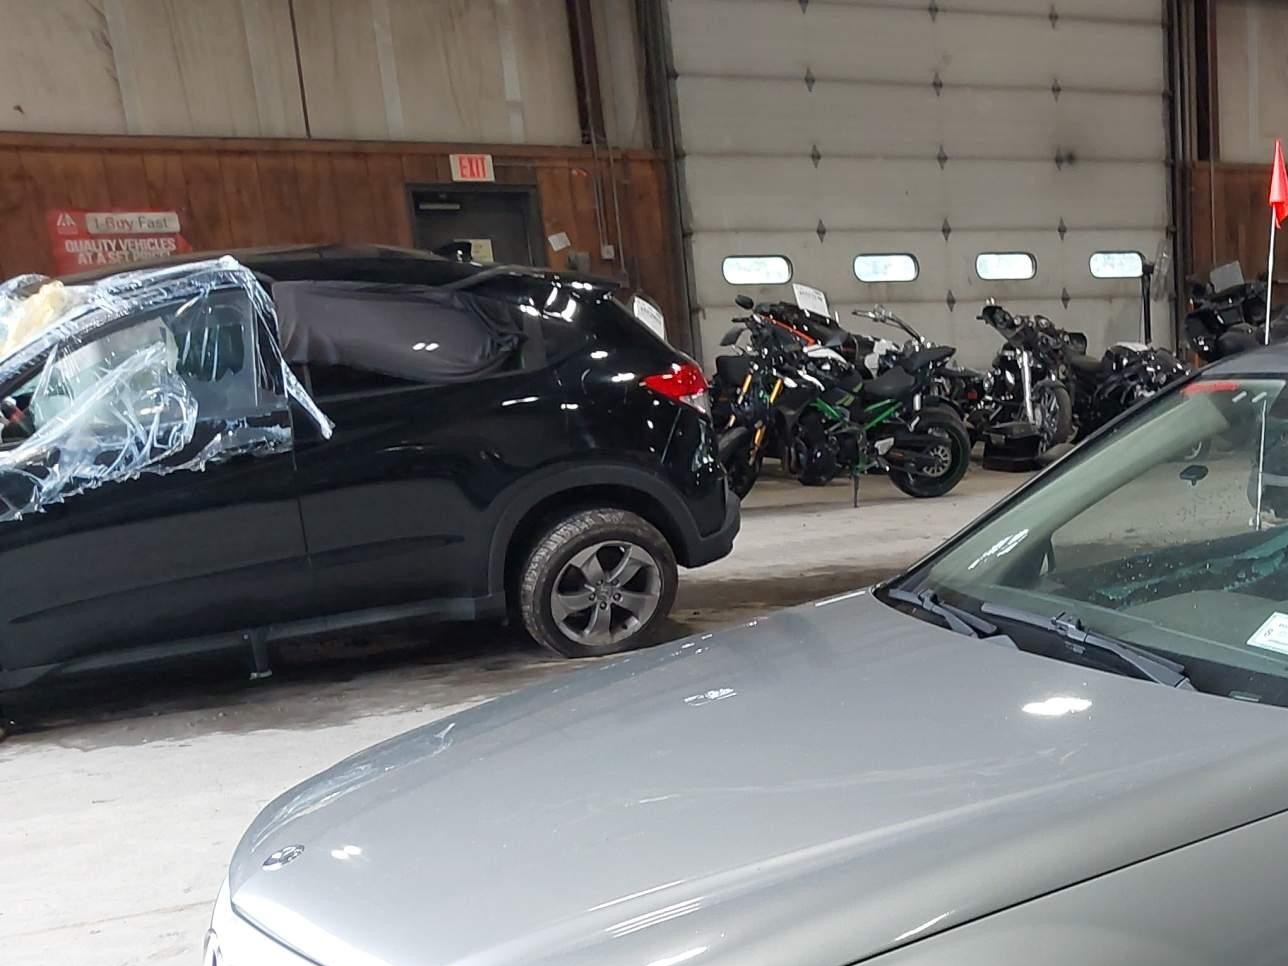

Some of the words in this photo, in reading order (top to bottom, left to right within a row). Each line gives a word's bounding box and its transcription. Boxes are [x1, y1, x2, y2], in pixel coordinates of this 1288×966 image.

[458, 155, 486, 178] EXIT
[138, 215, 169, 229] Fast
[64, 239, 118, 253] QUALITY
[118, 237, 177, 252] VEHICLES
[78, 252, 95, 265] AT
[97, 252, 107, 265] A
